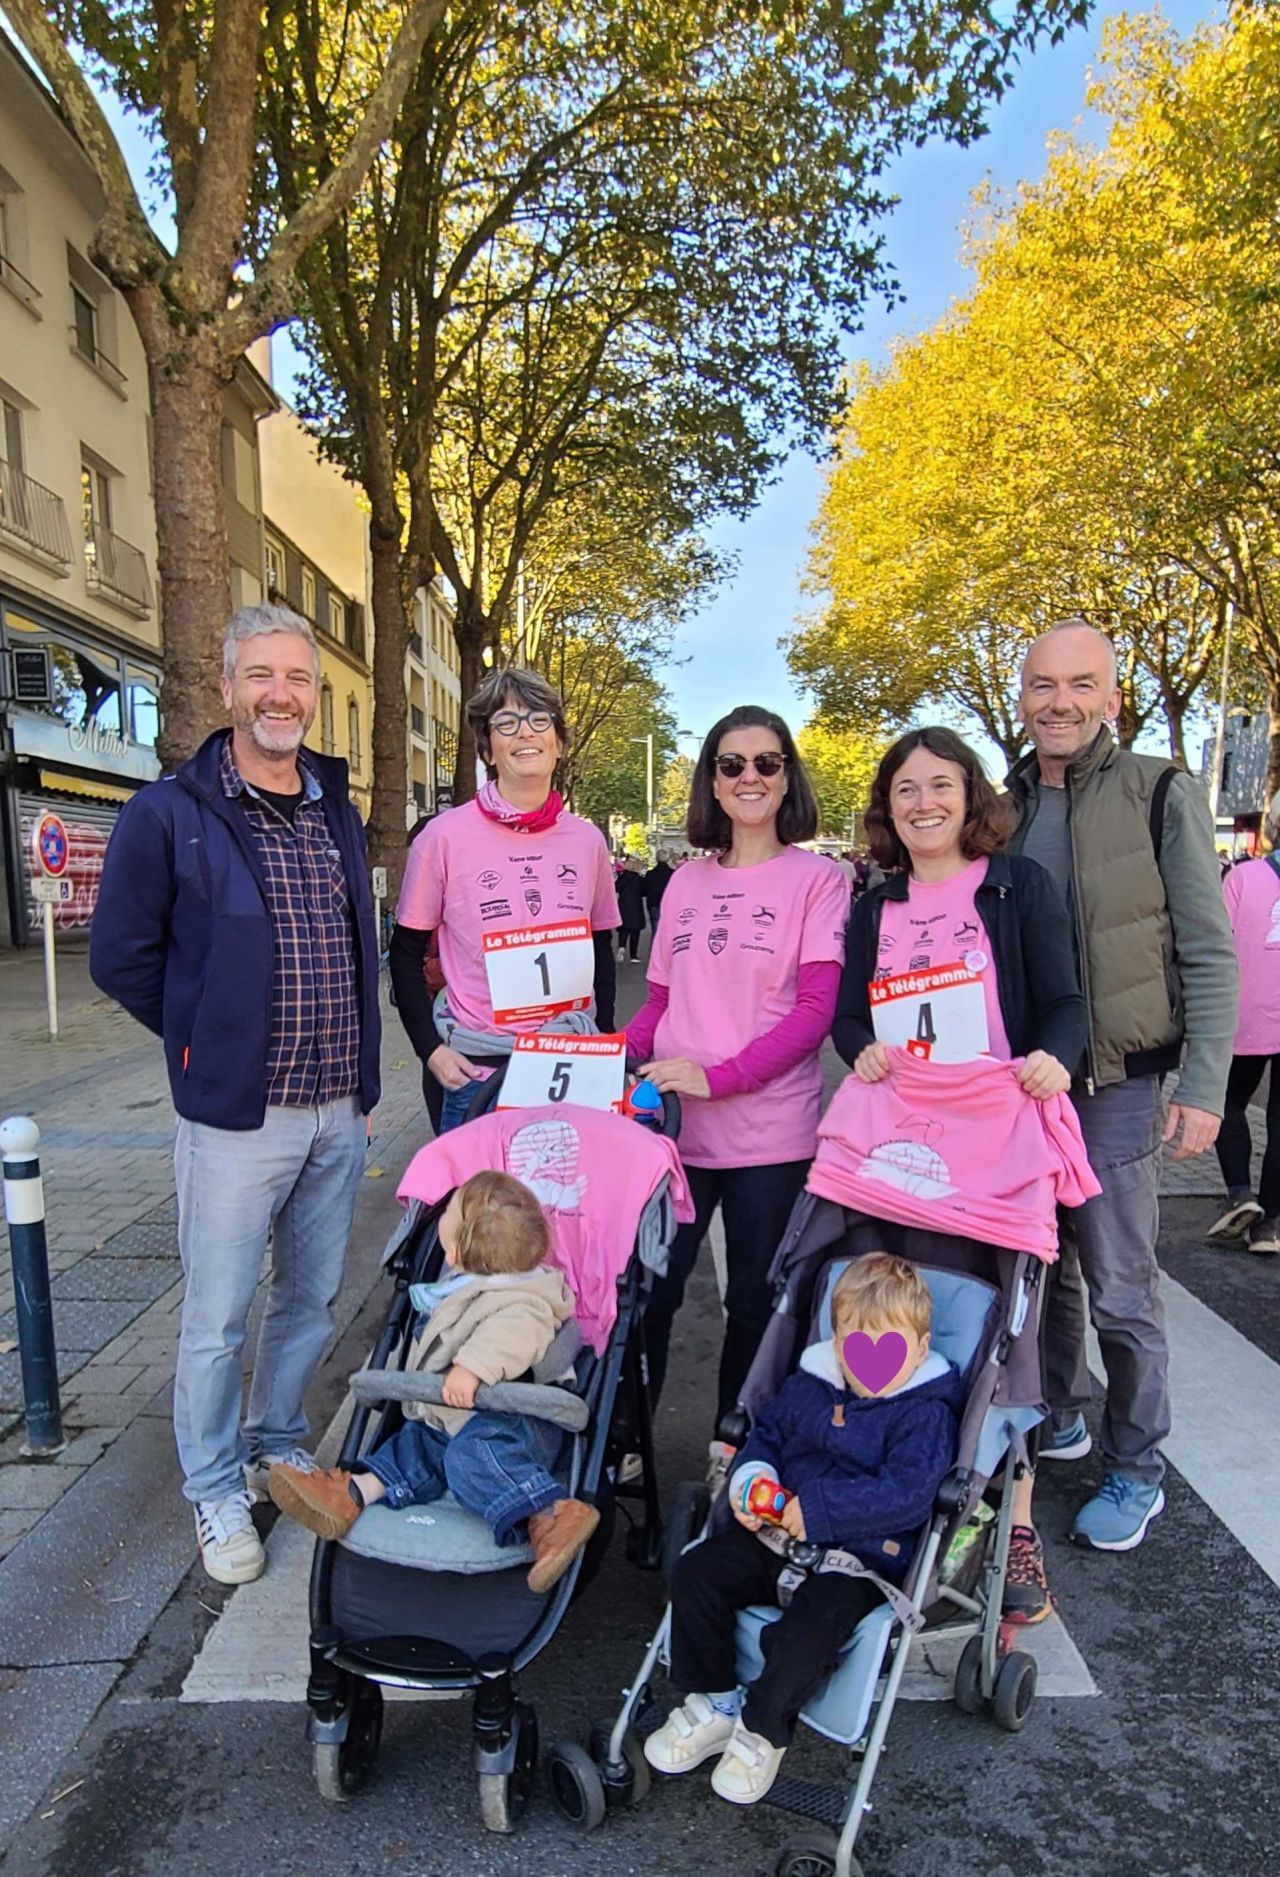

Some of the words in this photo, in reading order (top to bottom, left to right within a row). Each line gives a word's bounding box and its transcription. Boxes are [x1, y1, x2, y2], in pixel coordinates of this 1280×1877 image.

[486, 937, 503, 948] Le
[504, 926, 587, 944] Télégramme
[534, 952, 551, 996] 1
[871, 987, 887, 1001] Le
[888, 968, 976, 996] Télégramme
[917, 1002, 937, 1044] 4
[518, 1037, 535, 1049] Le
[538, 1037, 620, 1053] Télégramme
[548, 1062, 573, 1103] 5
